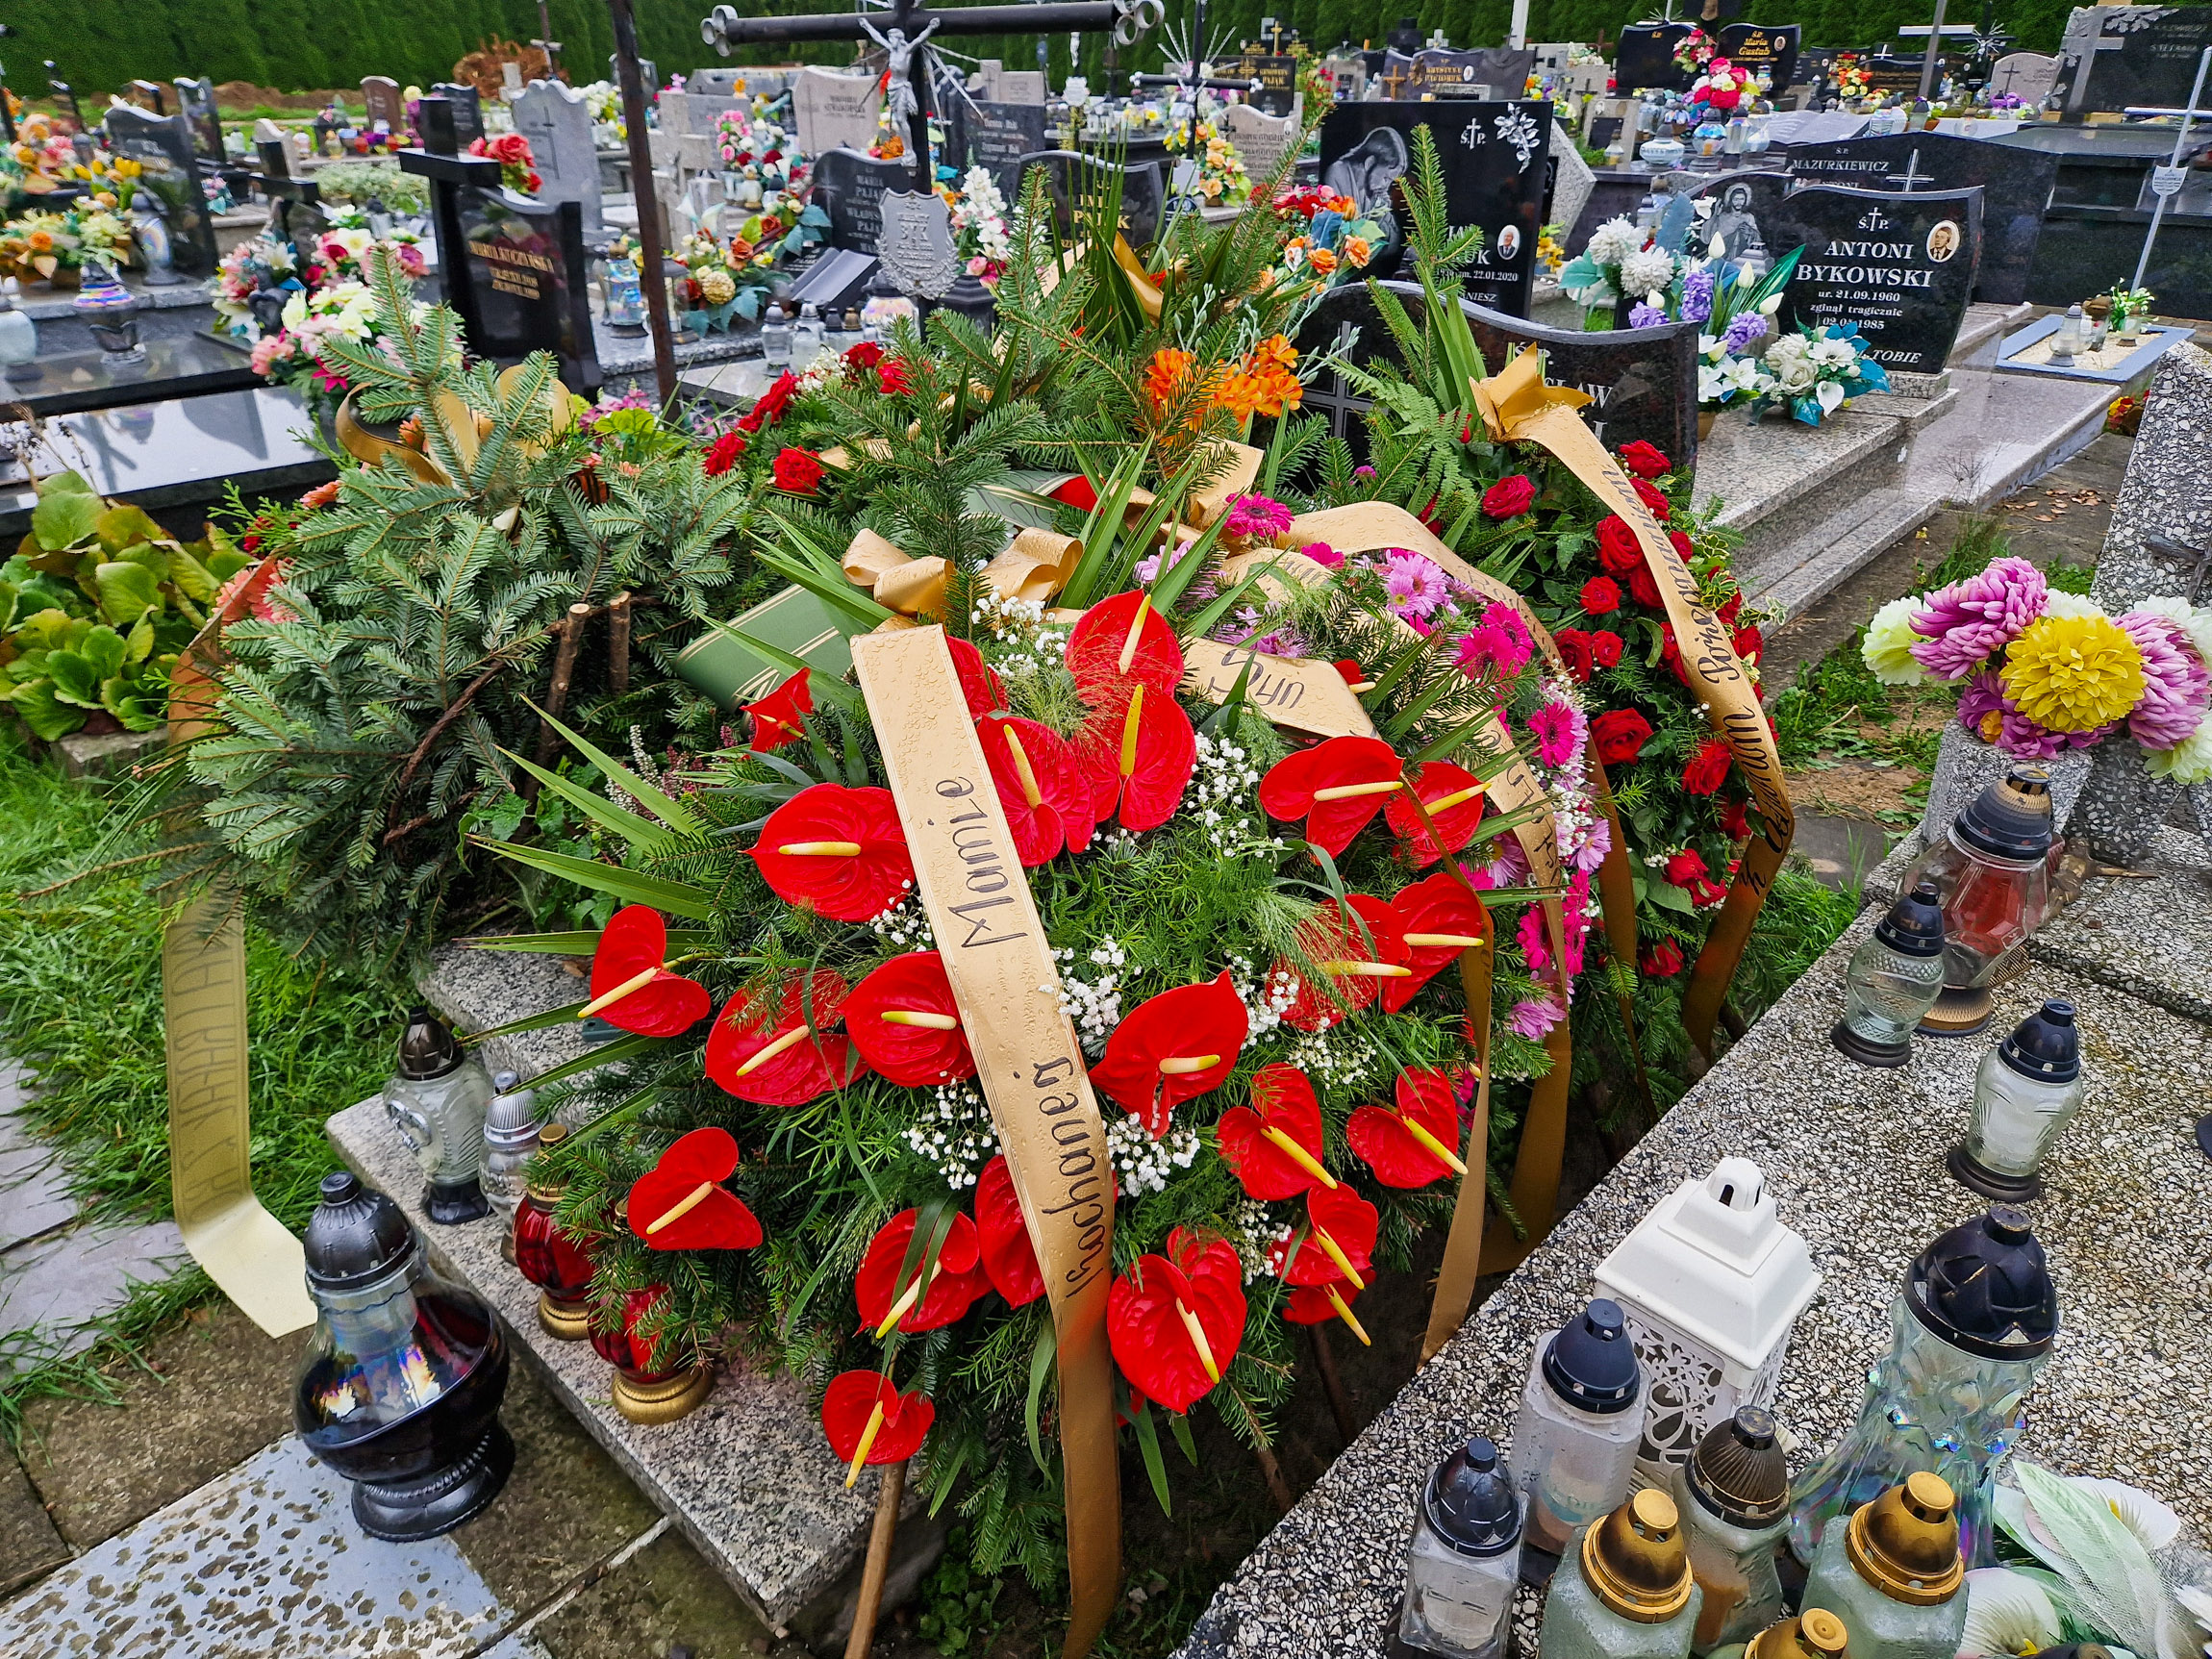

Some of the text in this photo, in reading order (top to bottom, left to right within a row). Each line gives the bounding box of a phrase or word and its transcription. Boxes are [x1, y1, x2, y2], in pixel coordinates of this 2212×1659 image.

[1792, 159, 1890, 172] MAZURKIEWICZ
[1823, 240, 1915, 260] ANTONI
[1473, 270, 1520, 282] 22.01.2020
[1795, 264, 1934, 288] BYKOWSKI
[1818, 290, 1901, 302] ur. 21.09.1960
[1810, 303, 1903, 317] zginął tragicznie
[1873, 349, 1923, 364] TOBIE
[1208, 647, 1305, 710] Syn
[927, 773, 1114, 1298] Kochanej Mamie
